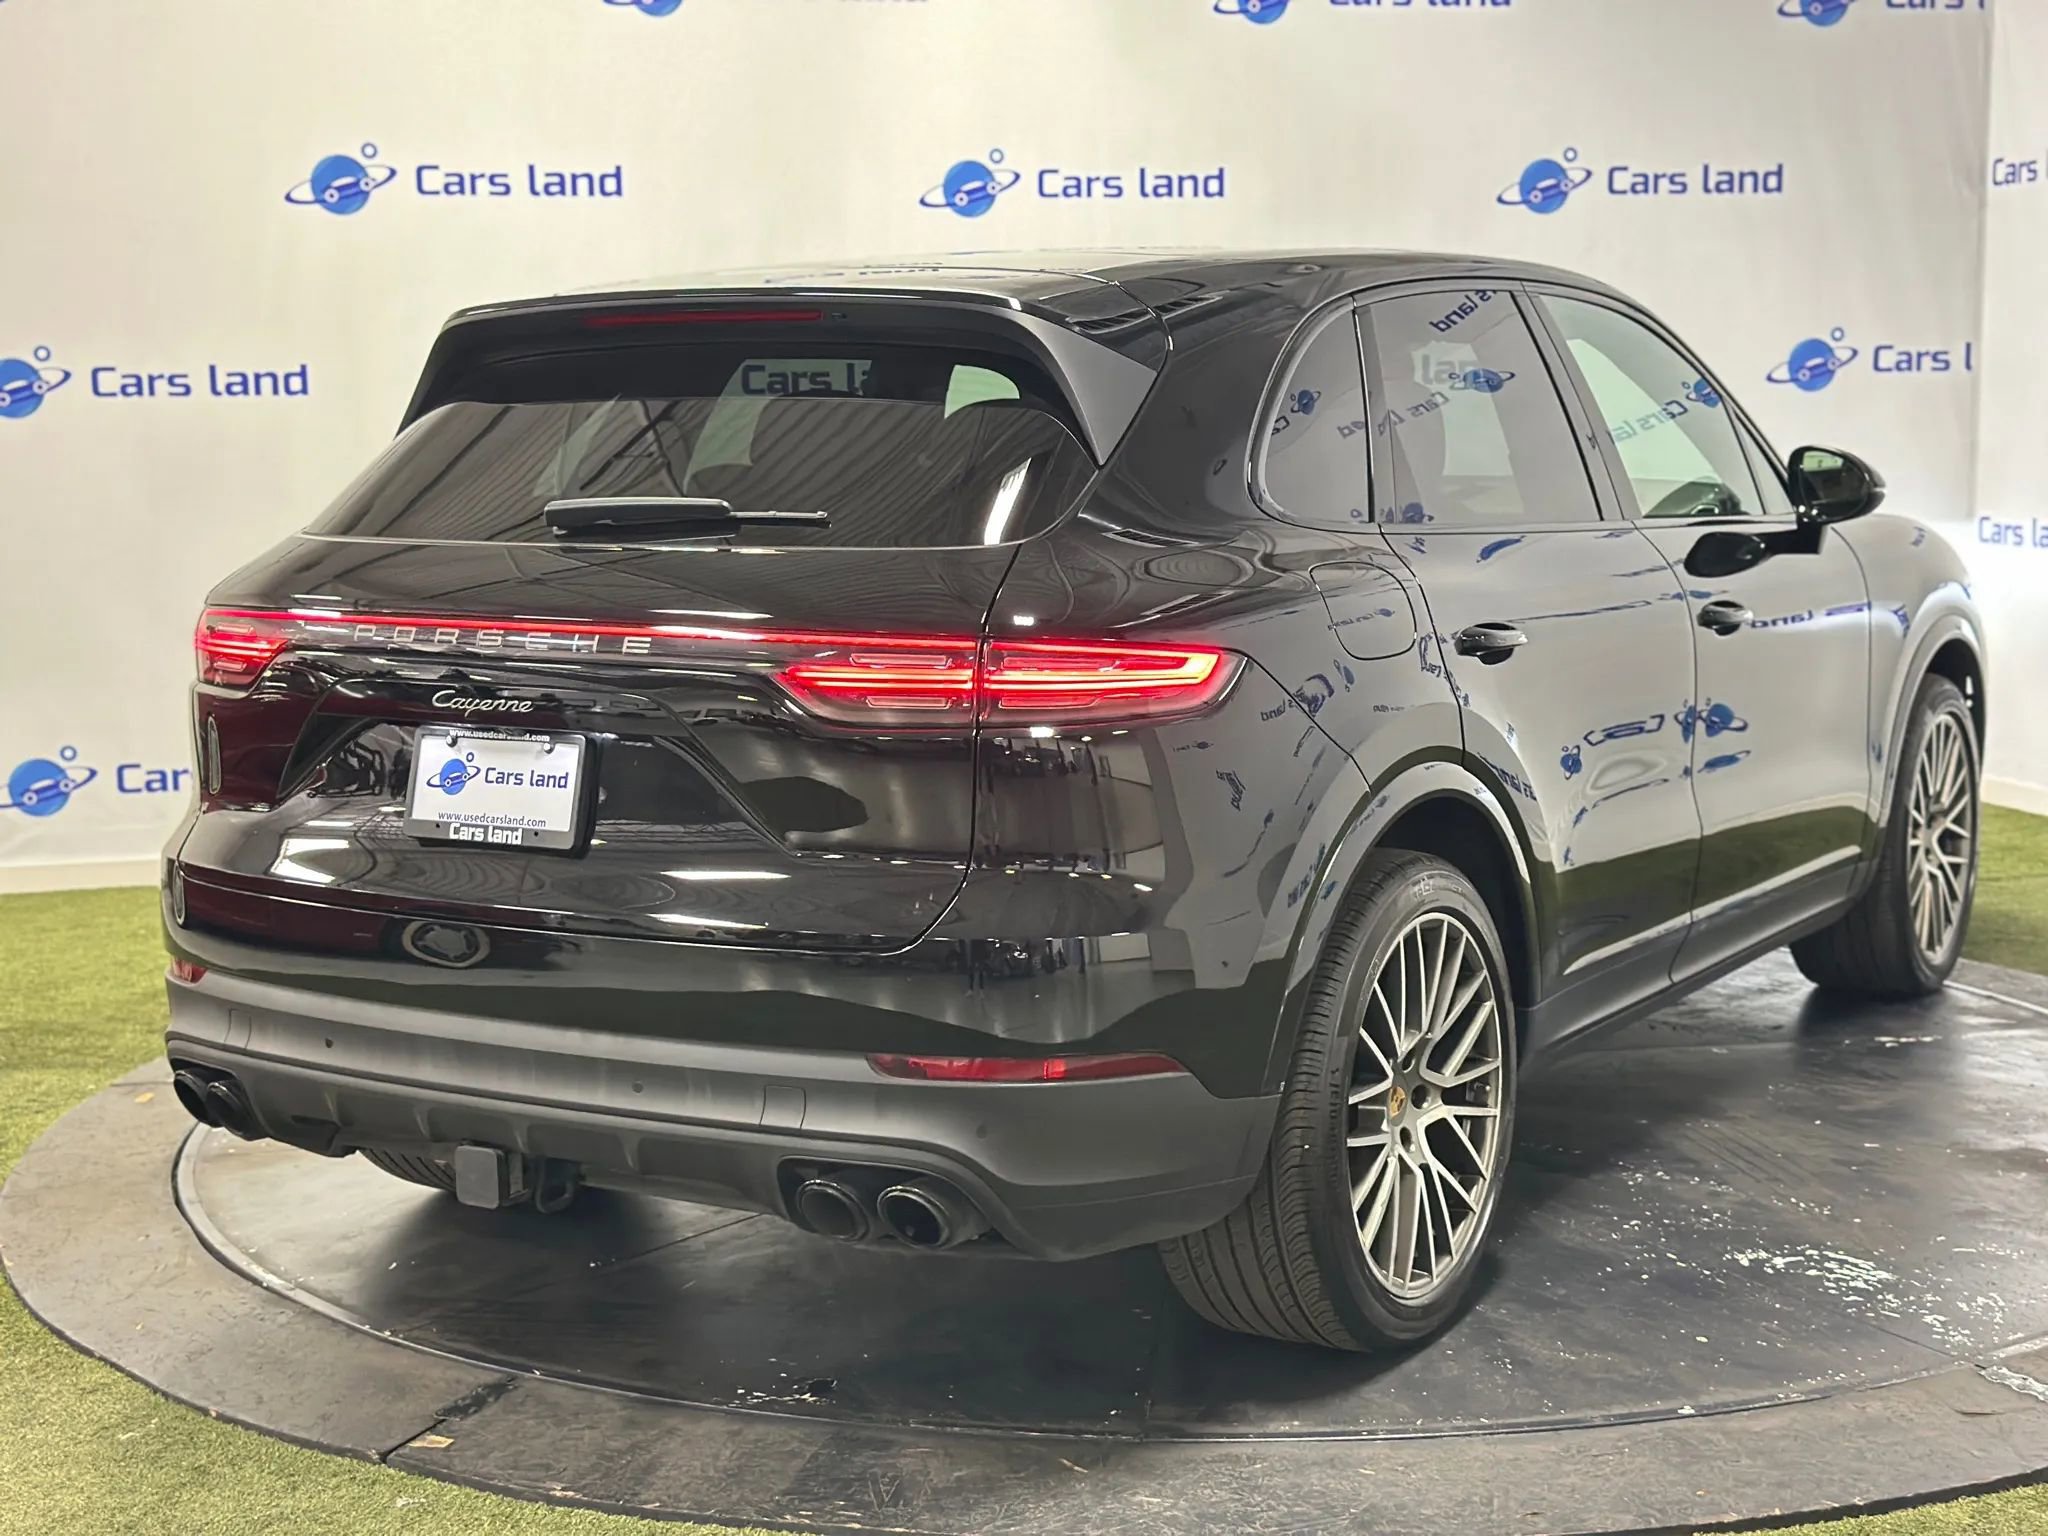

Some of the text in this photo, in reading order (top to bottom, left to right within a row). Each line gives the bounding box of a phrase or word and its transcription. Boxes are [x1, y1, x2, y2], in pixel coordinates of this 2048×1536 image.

[415, 164, 623, 197] Cars land
[1038, 167, 1224, 198] Cars land
[1607, 163, 1784, 195] Cars land
[1992, 158, 2037, 186] Cars
[1873, 345, 1951, 372] Cars
[91, 364, 309, 398] Cars land
[740, 364, 833, 397] Cars
[1979, 516, 2048, 548] Cars la
[353, 623, 652, 654] PORSCHE
[431, 689, 534, 717] Cayenne
[449, 728, 551, 743] www.usedcard.com
[116, 763, 190, 794] Car
[484, 767, 569, 789] Cars land
[437, 811, 547, 828] www.usedcarsland.com
[449, 822, 523, 845] Cars land
